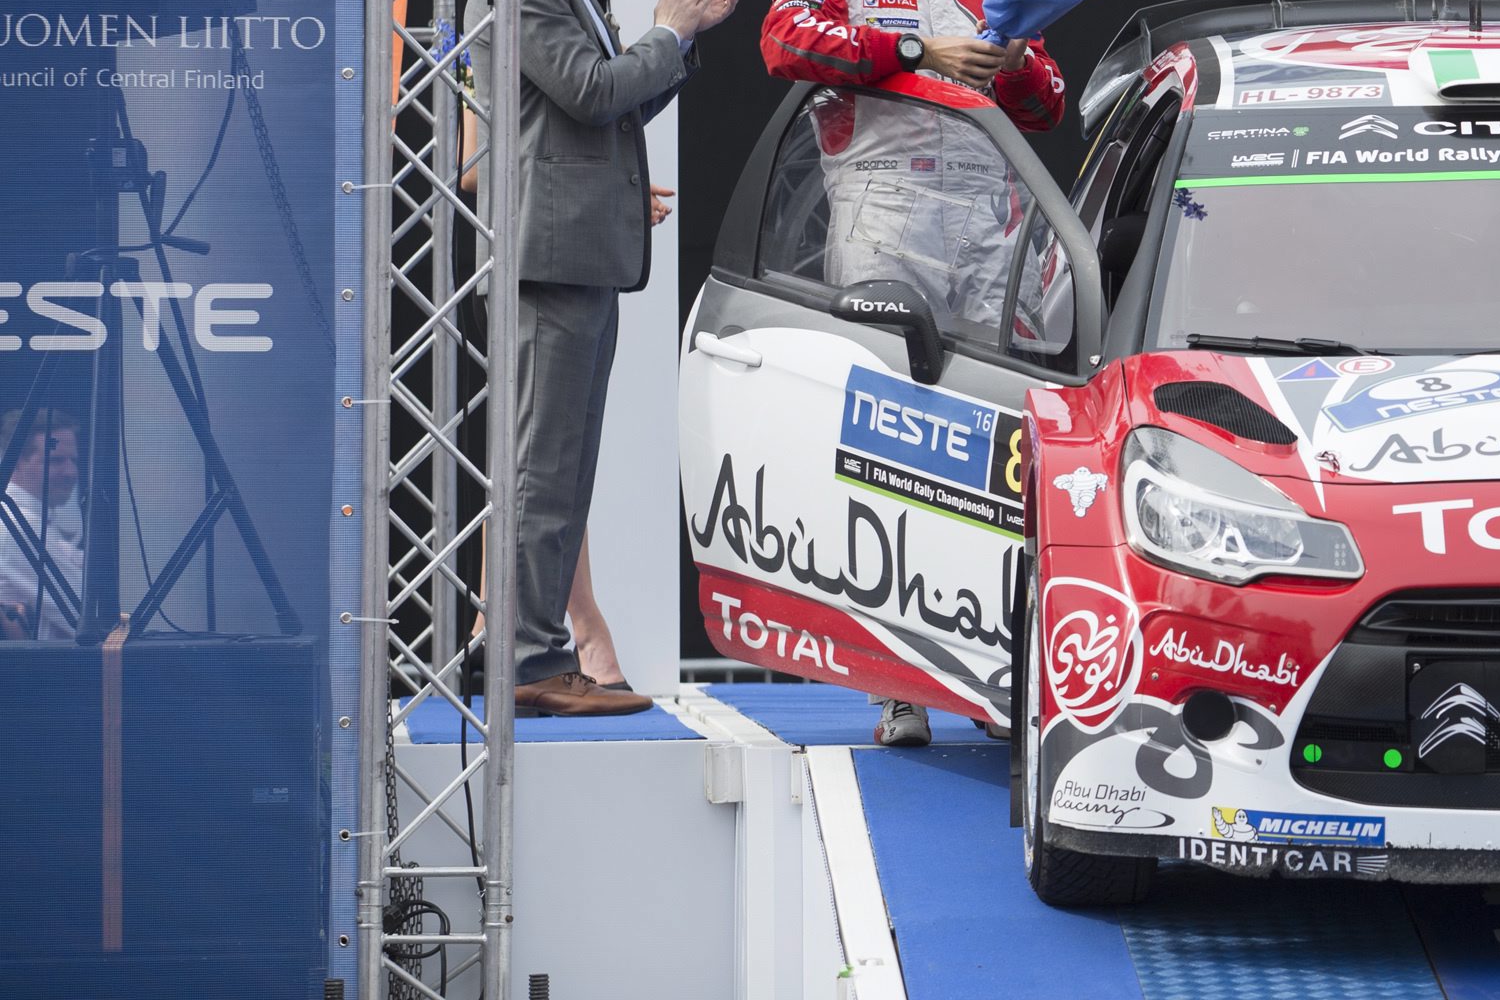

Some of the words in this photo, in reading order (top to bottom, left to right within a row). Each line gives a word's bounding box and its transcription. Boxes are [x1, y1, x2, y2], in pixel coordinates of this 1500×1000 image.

[179, 15, 326, 50] LIITTO
[882, 19, 918, 28] MICHELIN
[0, 67, 55, 87] uncil
[63, 67, 88, 87] of
[96, 68, 175, 89] Central
[184, 69, 264, 90] Finland
[1207, 127, 1290, 137] CERTINA
[1306, 150, 1347, 165] FIA
[1356, 148, 1429, 164] World
[1438, 147, 1500, 165] Rally
[947, 162, 955, 171] S.
[958, 163, 989, 174] MARTIN
[0, 283, 273, 351] STE
[850, 298, 910, 313] TOTAL
[1415, 376, 1452, 392] 8
[852, 390, 972, 462] NESTE
[1005, 428, 1022, 493] 8
[873, 467, 887, 481] FIA
[889, 472, 912, 492] World
[914, 481, 935, 502] Rally
[936, 488, 995, 521] Championship
[712, 592, 849, 676] TOTAL
[1063, 780, 1092, 798] Abu
[1095, 785, 1147, 803] Dhabi
[1054, 789, 1141, 825] Racing
[1258, 817, 1383, 839] MICHELIN
[1179, 837, 1352, 874] IDENTICAR
